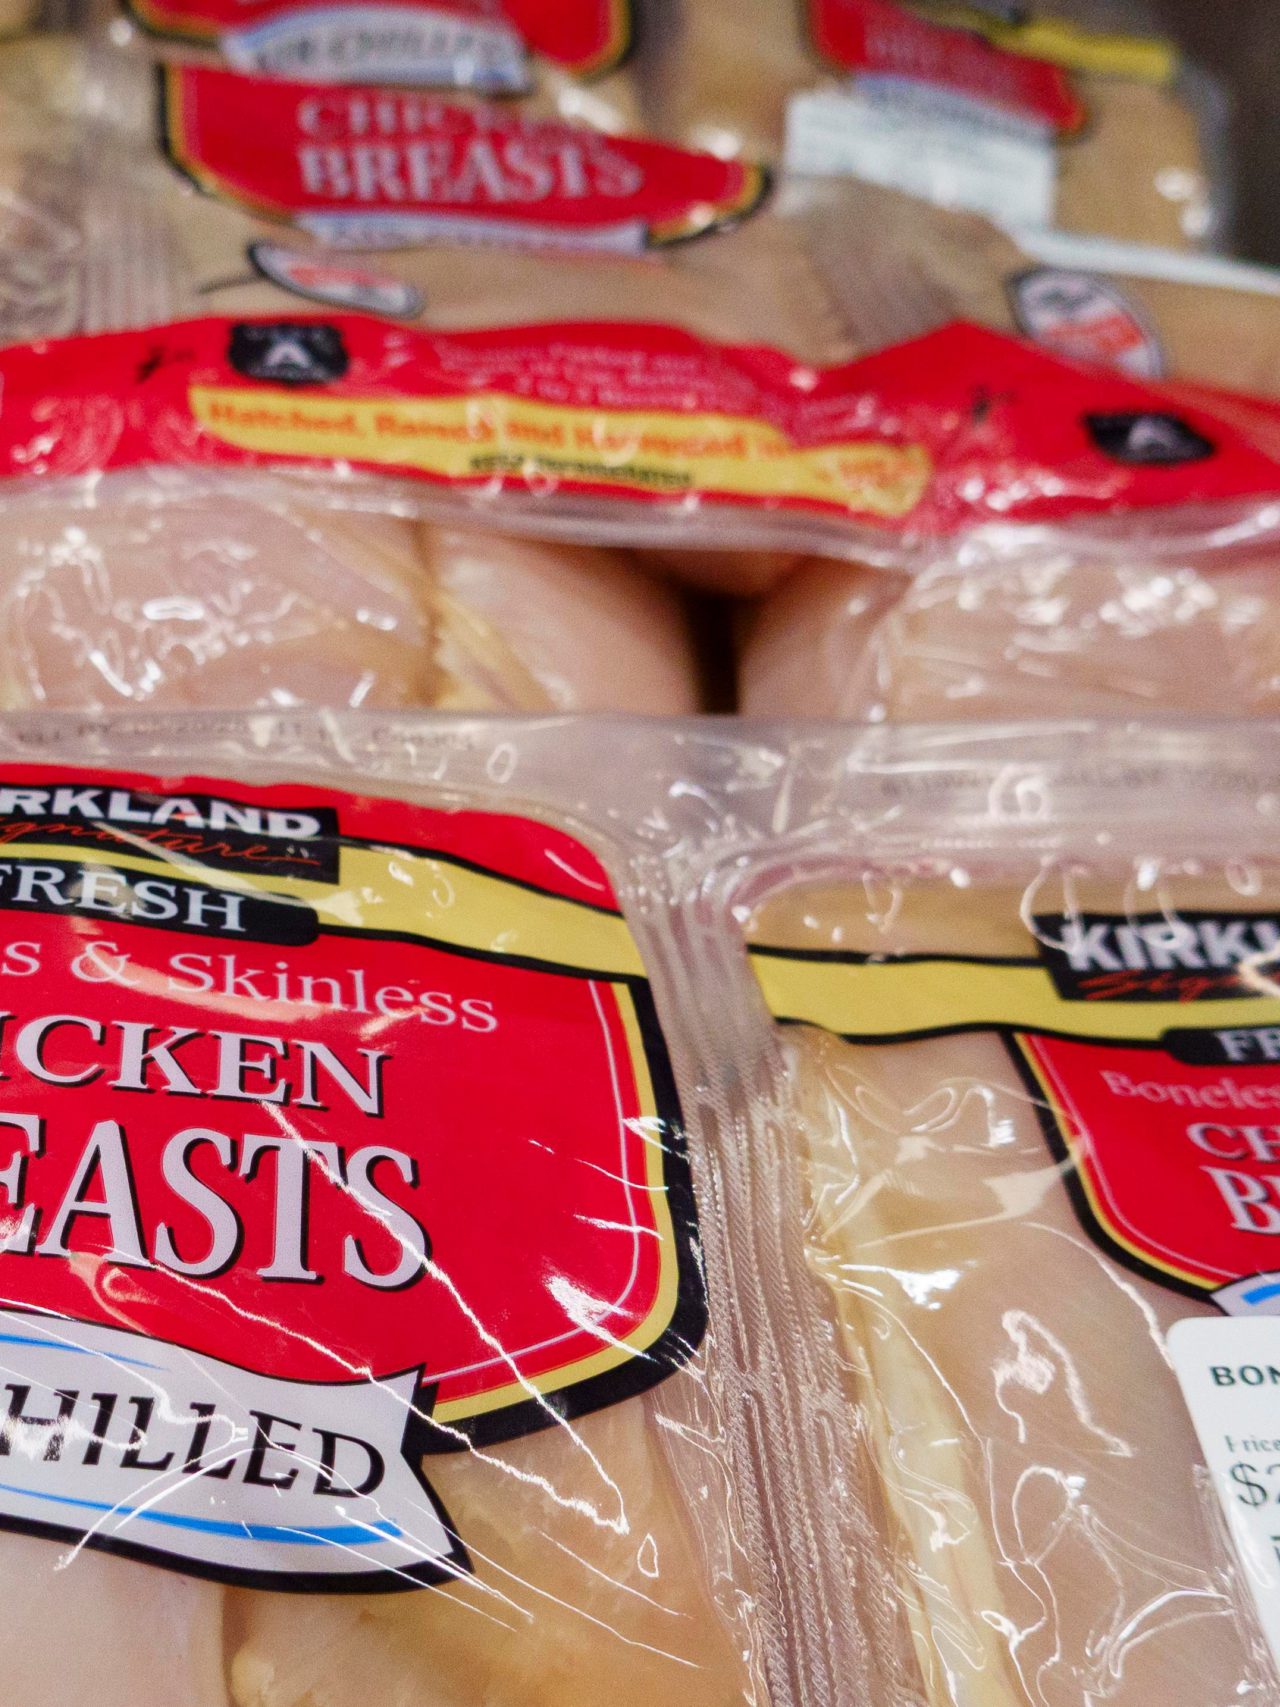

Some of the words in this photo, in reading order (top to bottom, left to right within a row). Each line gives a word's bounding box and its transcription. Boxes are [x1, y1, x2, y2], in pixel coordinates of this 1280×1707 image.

[297, 138, 644, 202] BREASTS
[71, 940, 142, 991] &
[168, 953, 499, 1035] Skinless
[1200, 1165, 1280, 1236] B
